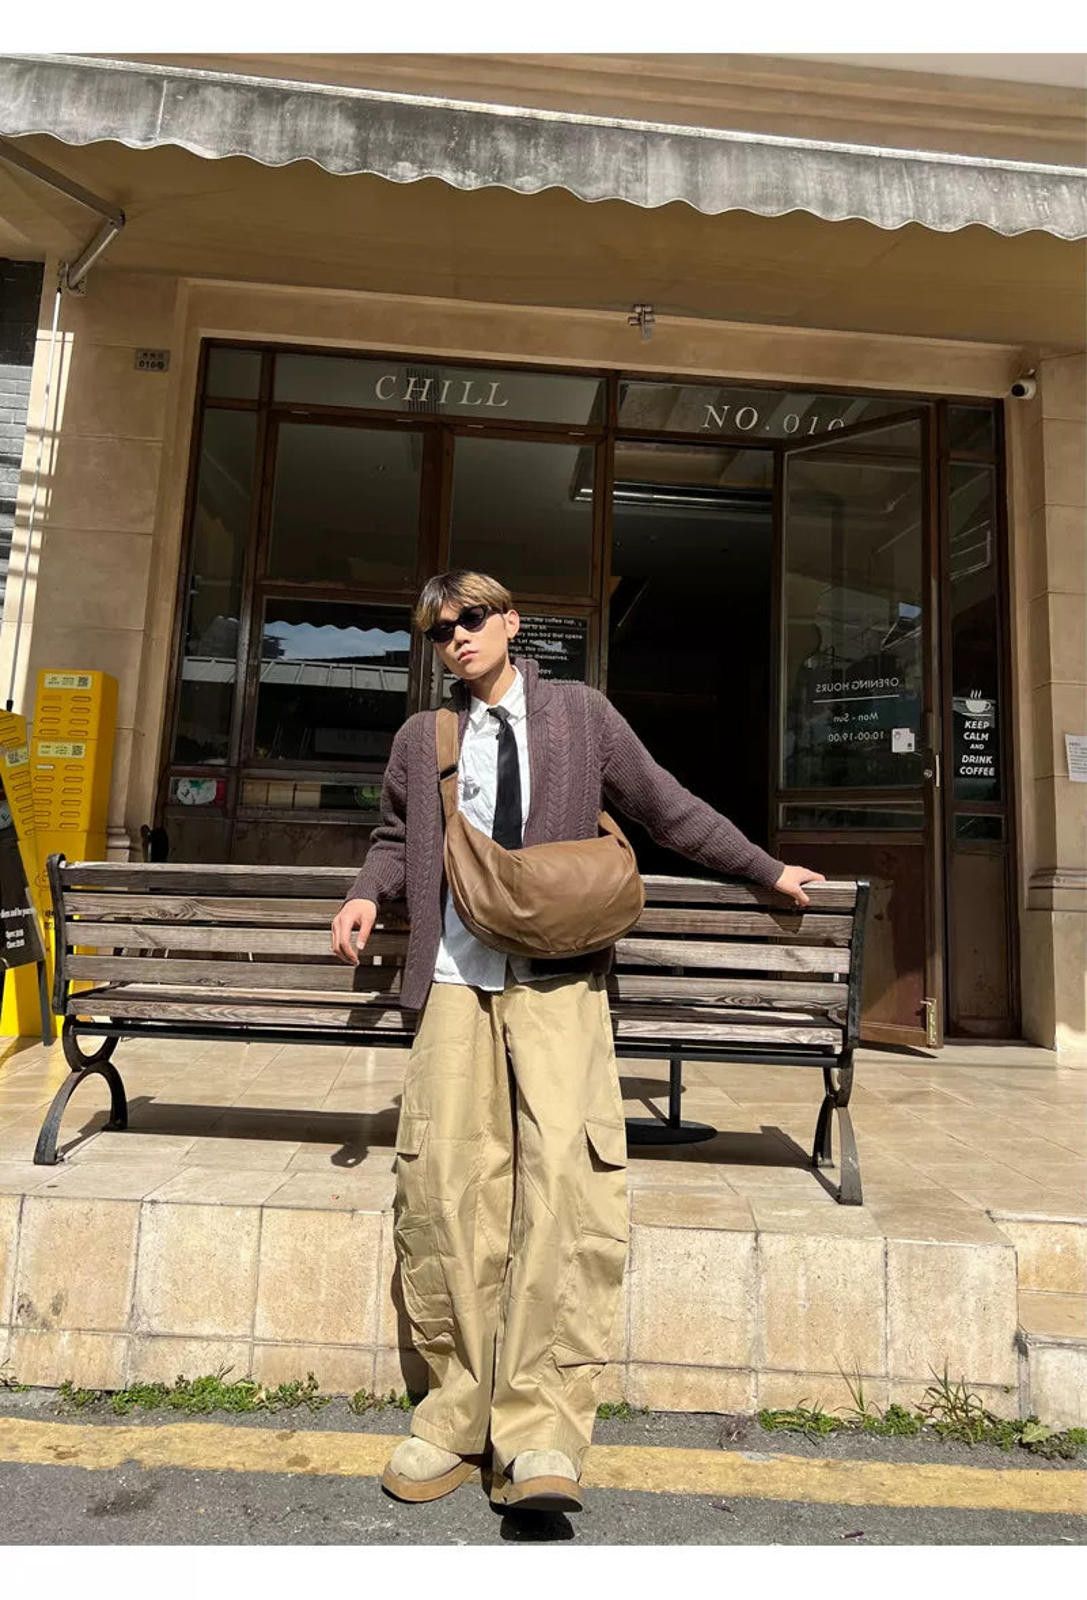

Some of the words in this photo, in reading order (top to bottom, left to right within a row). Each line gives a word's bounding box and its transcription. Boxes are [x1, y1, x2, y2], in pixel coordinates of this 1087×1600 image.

[375, 375, 509, 407] CHILL
[964, 720, 990, 729] KEEP
[963, 732, 989, 741] CALM
[961, 755, 993, 764] DRINK
[960, 766, 995, 776] COFFEE
